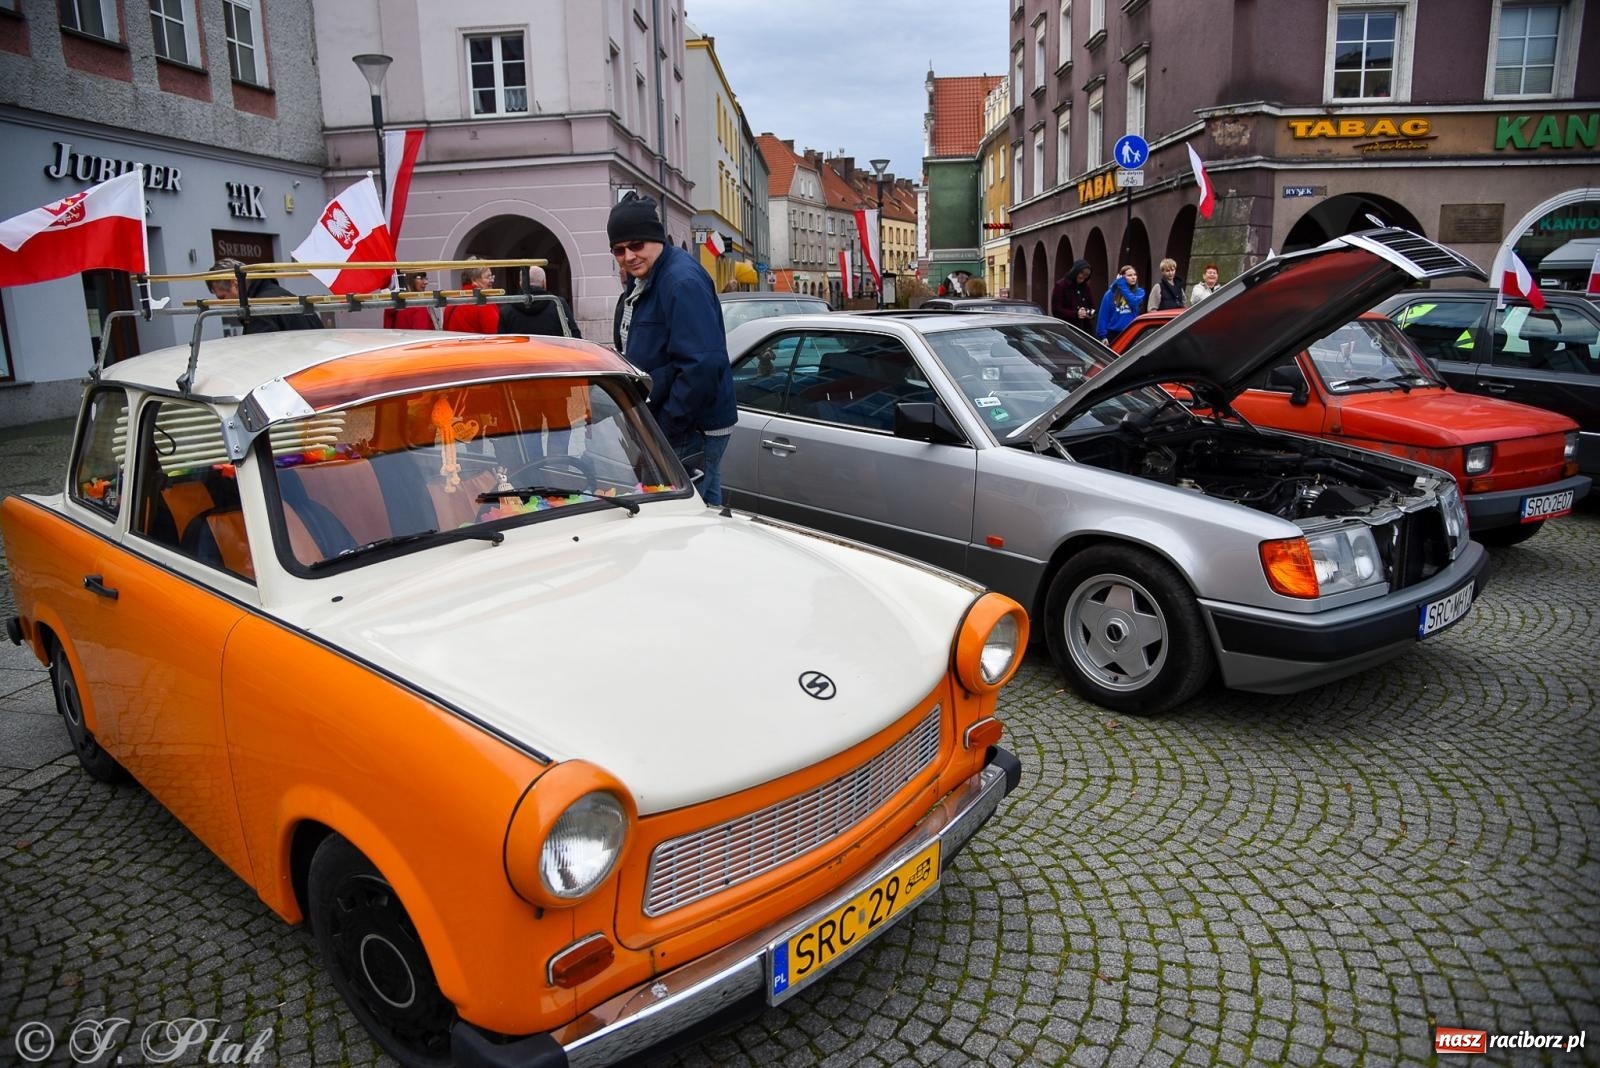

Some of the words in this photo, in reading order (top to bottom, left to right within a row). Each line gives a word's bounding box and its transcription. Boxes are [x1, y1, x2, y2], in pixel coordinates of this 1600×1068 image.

[1288, 118, 1431, 138] TABAC
[46, 142, 182, 191] JUBIER
[218, 240, 262, 258] SREBRO
[1527, 496, 1549, 516] SRC
[1428, 599, 1451, 629] SRC
[795, 905, 856, 975] SRC
[868, 875, 900, 930] 29
[774, 974, 787, 988] PL
